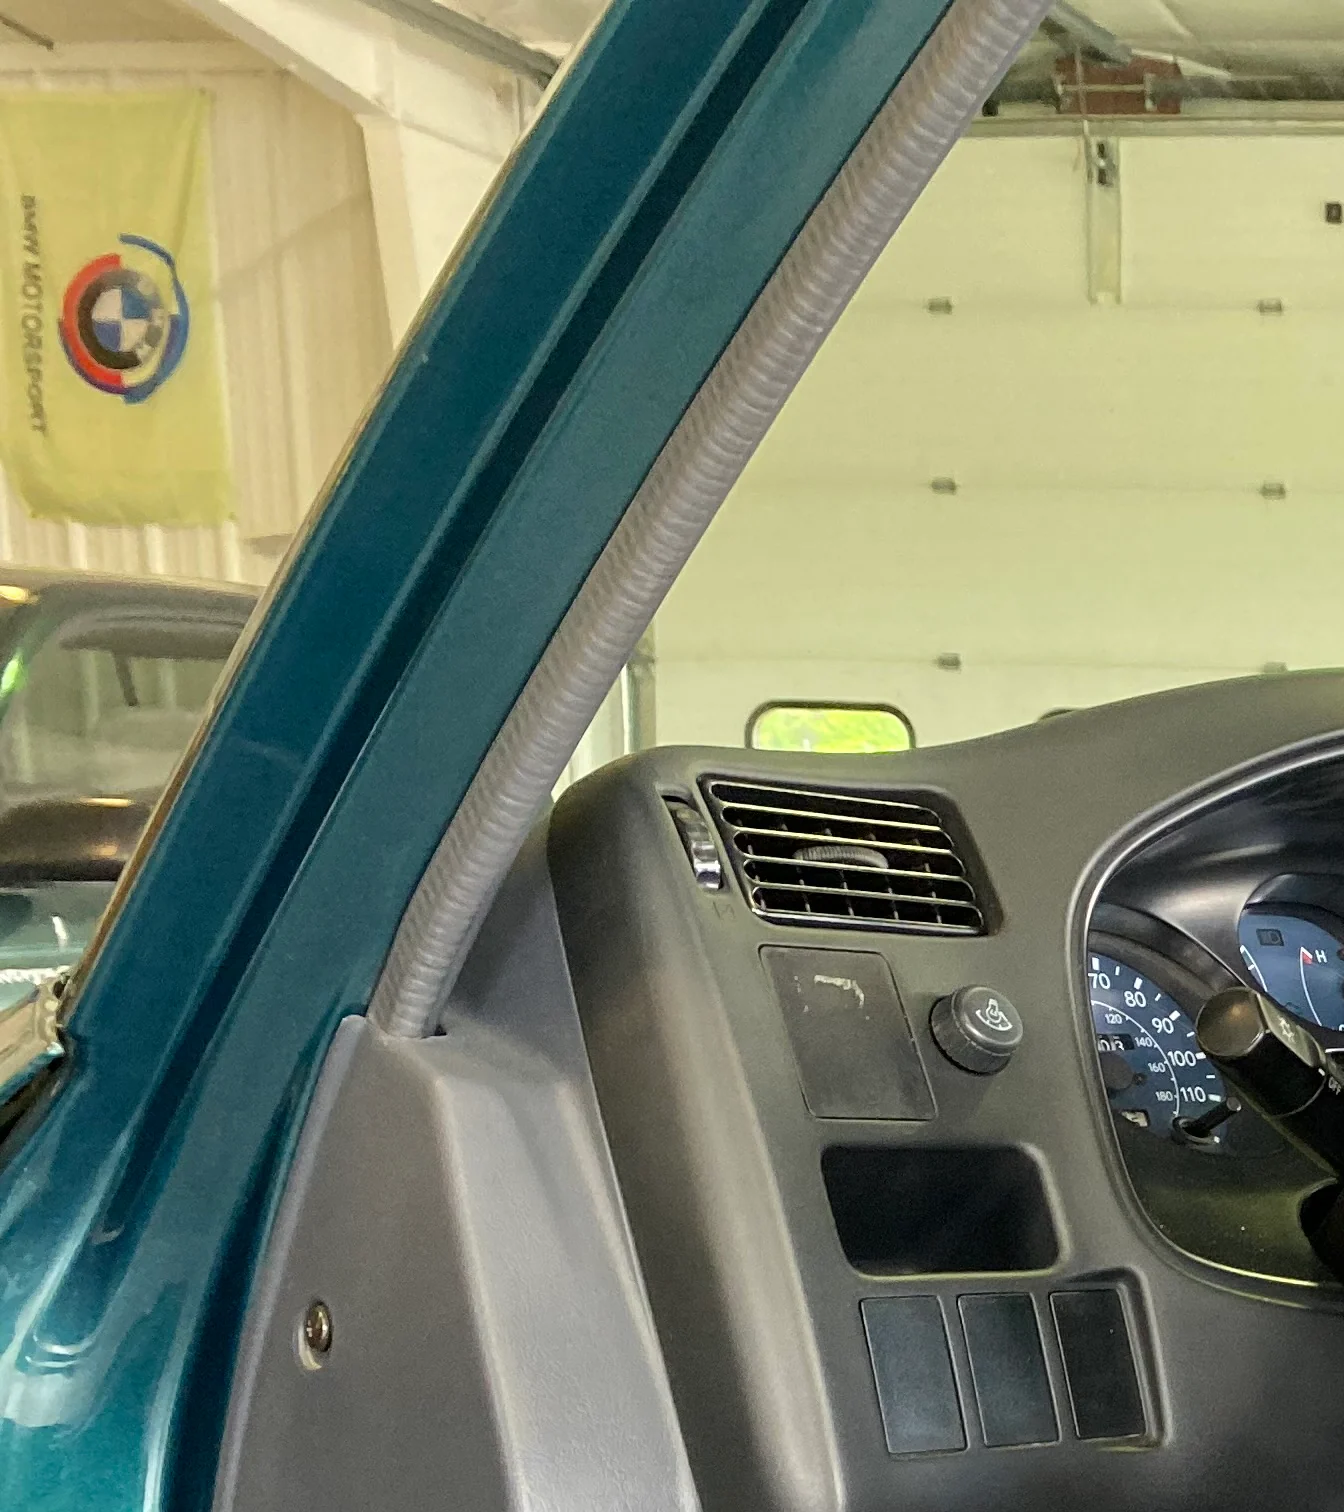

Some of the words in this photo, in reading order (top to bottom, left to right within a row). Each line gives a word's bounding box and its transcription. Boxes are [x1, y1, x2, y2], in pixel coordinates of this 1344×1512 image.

[21, 195, 40, 257] BMW
[21, 261, 47, 437] MOTORSPORT
[1088, 973, 1111, 990] 70
[1124, 991, 1147, 1008] 80
[1104, 1013, 1123, 1025] 120
[1151, 1017, 1175, 1034] 90
[1134, 1036, 1153, 1048] 140
[1167, 1050, 1197, 1067] 100
[1147, 1062, 1166, 1073] 160
[1155, 1090, 1173, 1102] 180
[1180, 1086, 1207, 1103] 110
